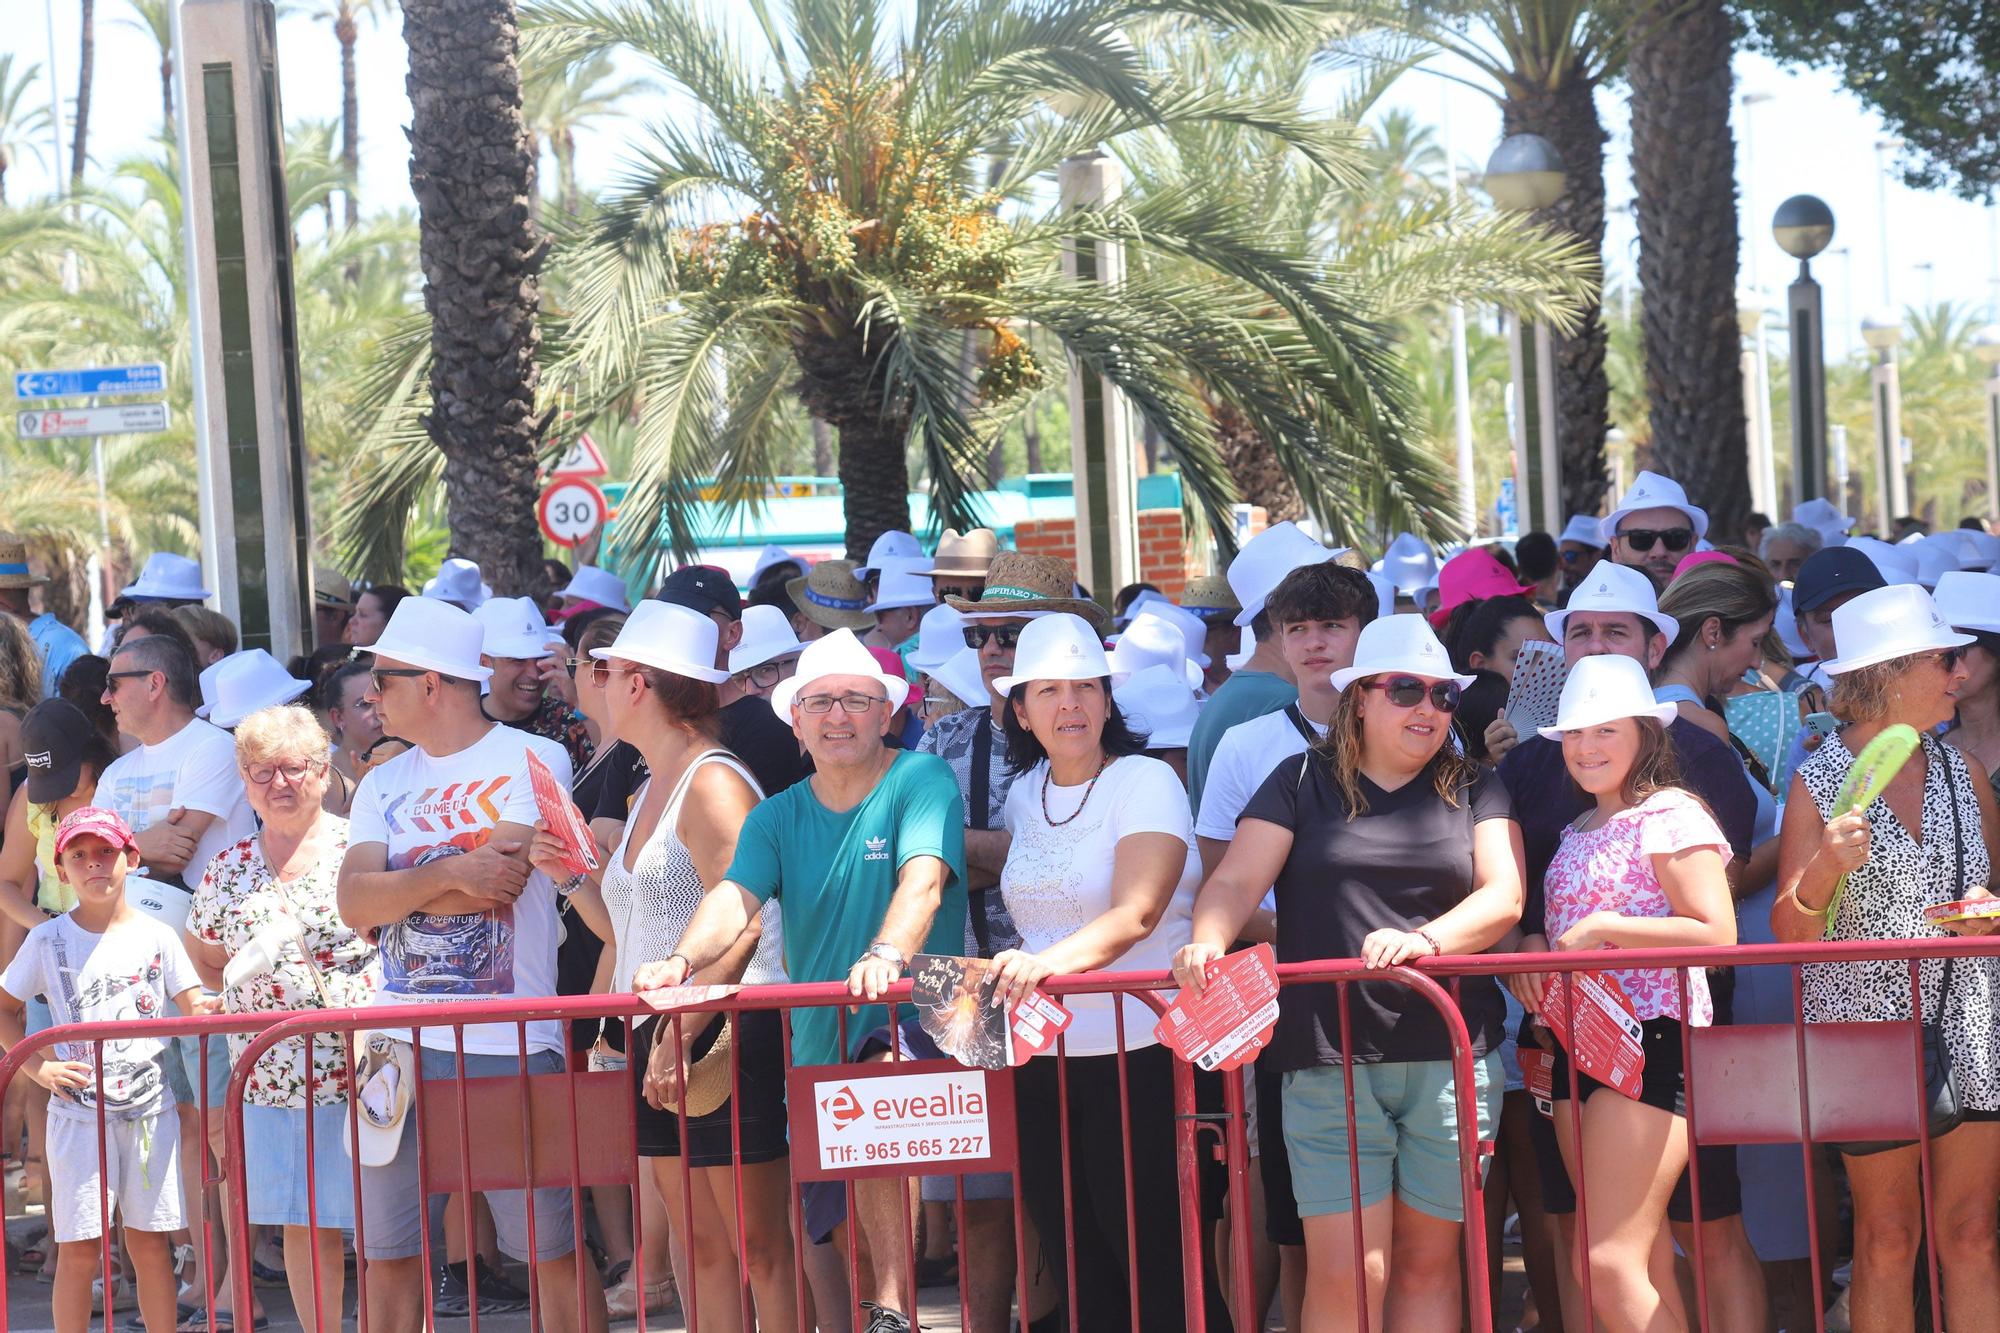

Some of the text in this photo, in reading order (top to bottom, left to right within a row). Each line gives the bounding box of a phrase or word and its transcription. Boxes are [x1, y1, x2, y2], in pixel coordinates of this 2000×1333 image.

[555, 502, 590, 523] 30
[864, 851, 889, 860] adidas
[423, 914, 480, 925] ADVENTURE
[873, 1083, 983, 1121] evealia
[925, 1120, 949, 1128] SERVICIOS
[865, 1141, 901, 1161] 965
[907, 1138, 942, 1158] 665
[949, 1136, 984, 1154] 227
